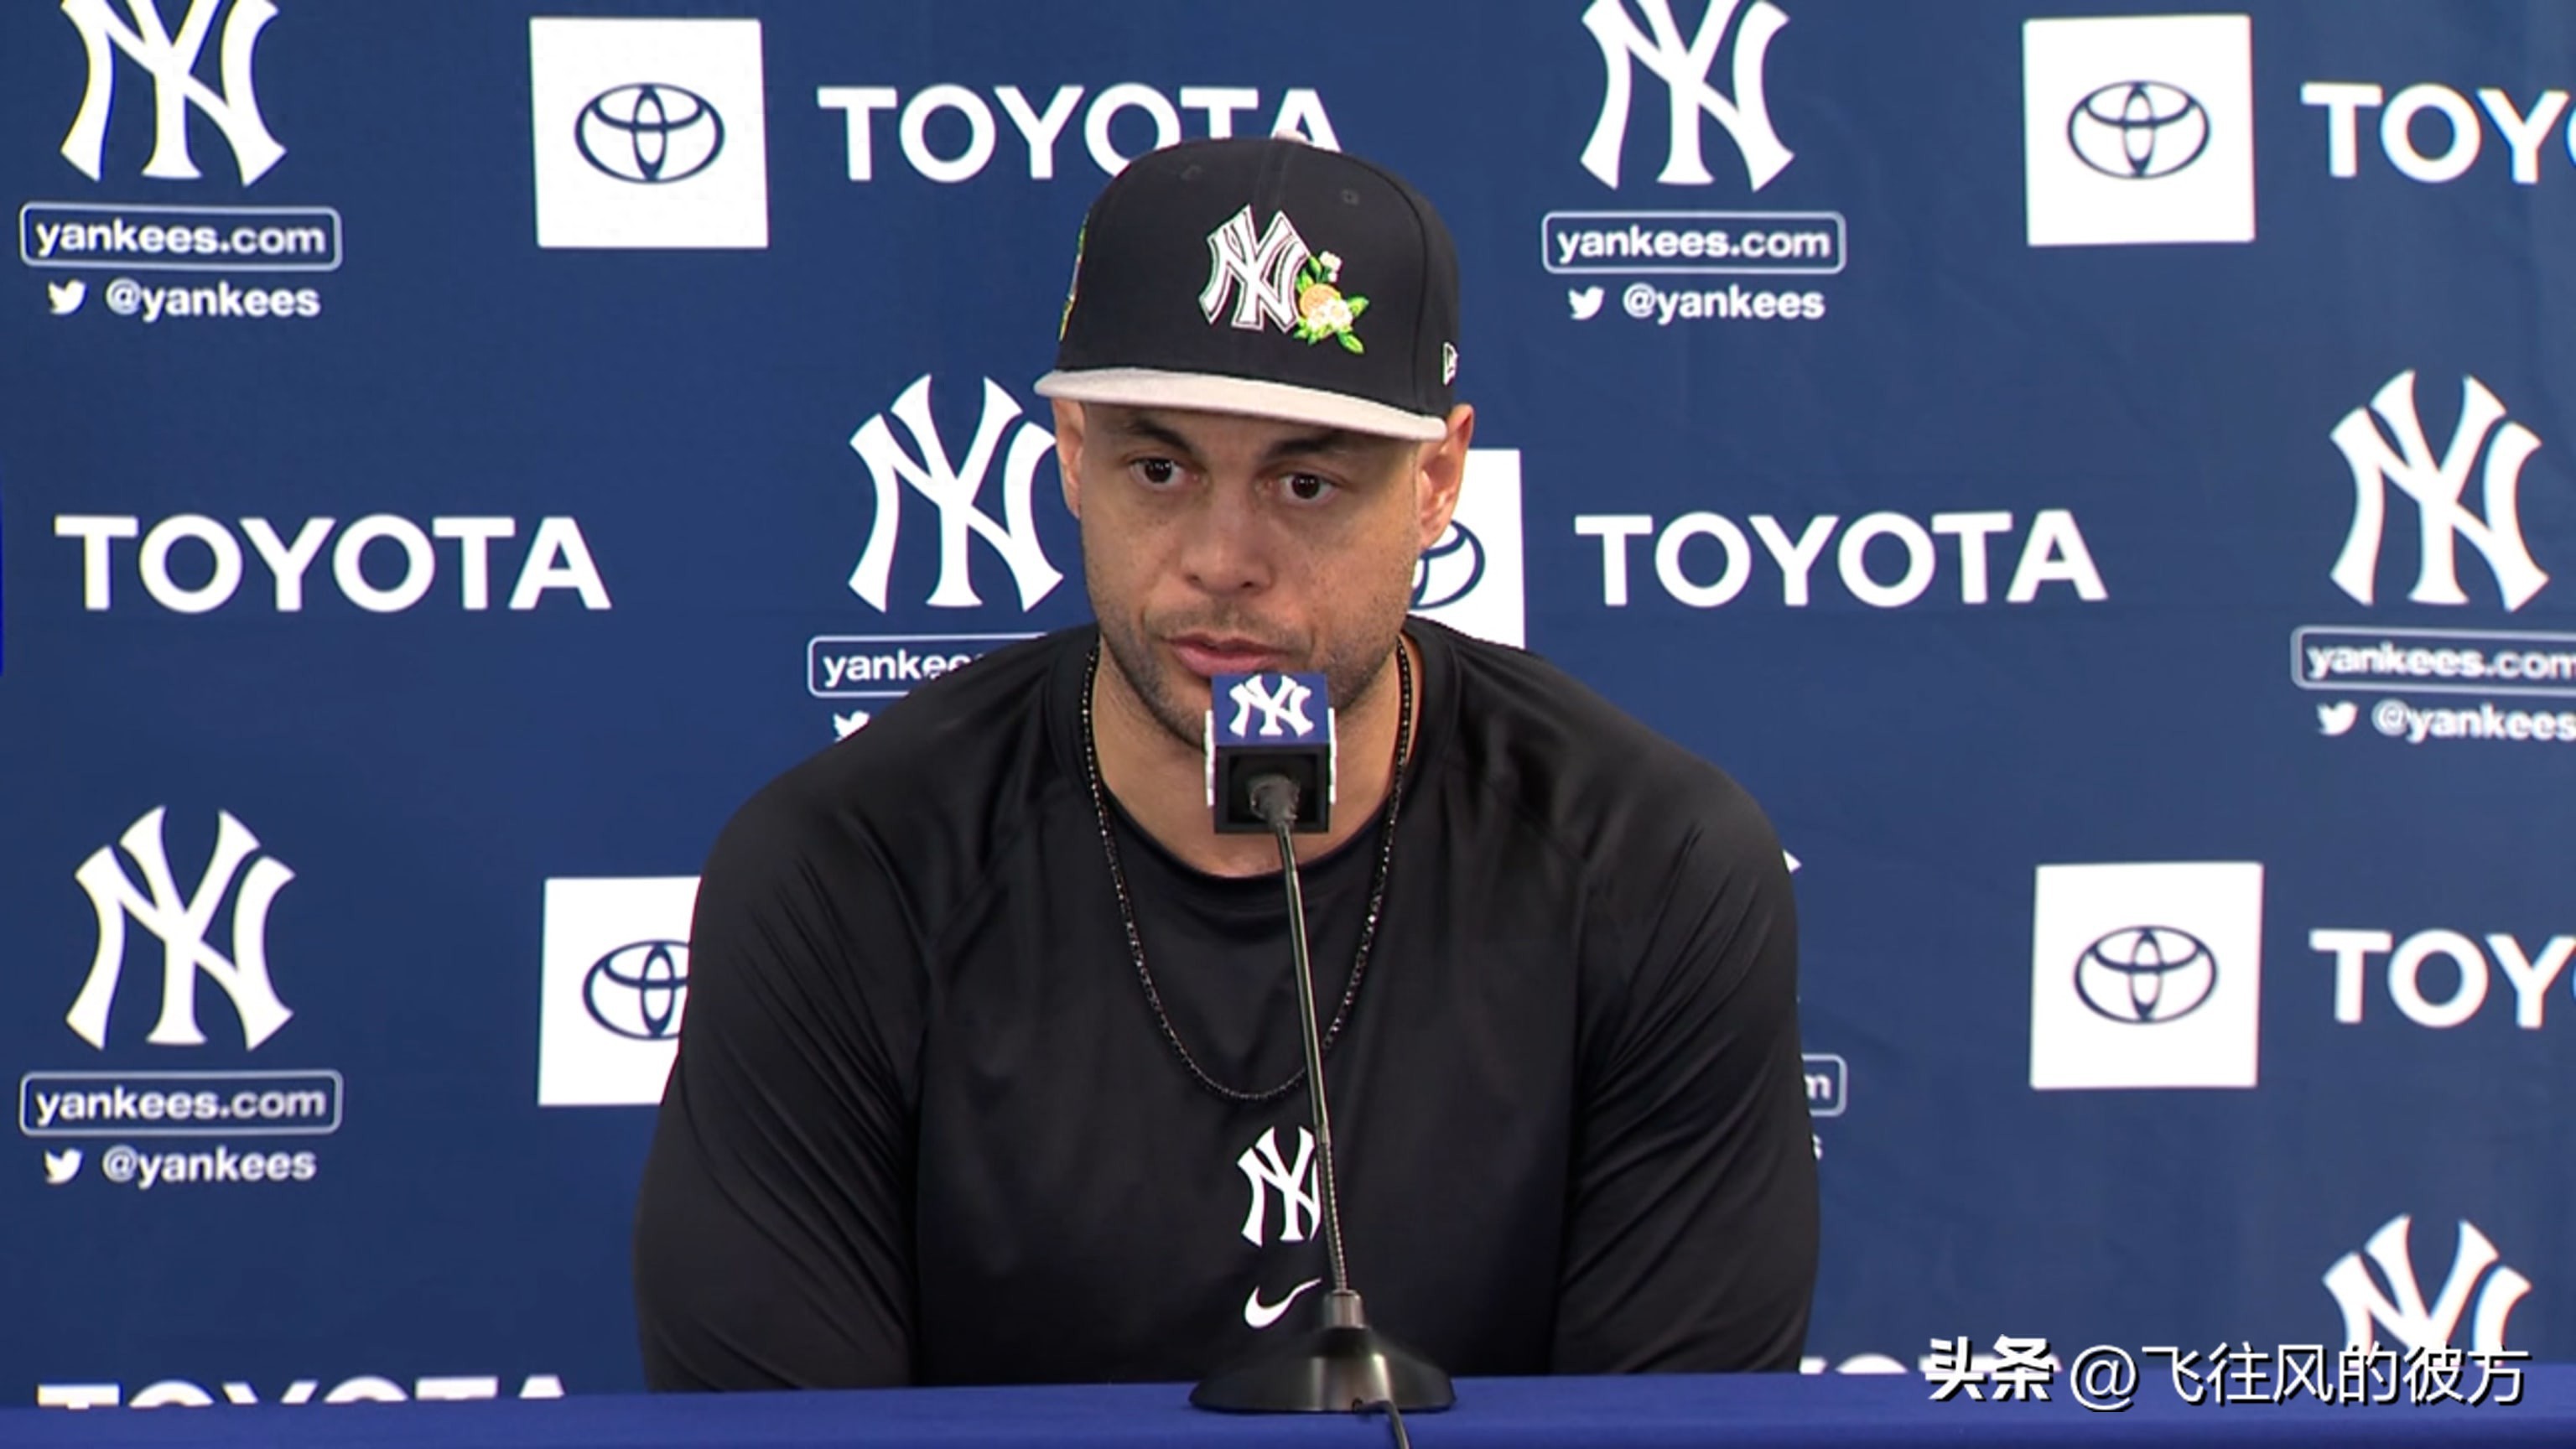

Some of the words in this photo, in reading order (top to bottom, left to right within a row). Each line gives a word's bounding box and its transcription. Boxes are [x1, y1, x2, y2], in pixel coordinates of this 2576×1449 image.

[60, 0, 286, 186] NY
[1580, 0, 1794, 192] NY
[2300, 82, 2576, 184] TOY
[36, 219, 327, 257] yankees.com
[1198, 204, 1311, 334] NY
[1556, 225, 1831, 264] yankees.com
[105, 278, 321, 323] @yankees
[1623, 282, 1826, 325] @yankees
[848, 373, 1065, 614] NY
[2329, 369, 2551, 613] NY
[55, 513, 612, 614] TOYOTA
[1574, 510, 2108, 608] TOYOTA
[1228, 673, 1316, 738] NY
[2371, 698, 2576, 745] @yankees
[65, 805, 296, 1051] NY
[2309, 928, 2576, 1029] TOY
[35, 1086, 326, 1127] yankees.com
[102, 1145, 317, 1189] @yankees
